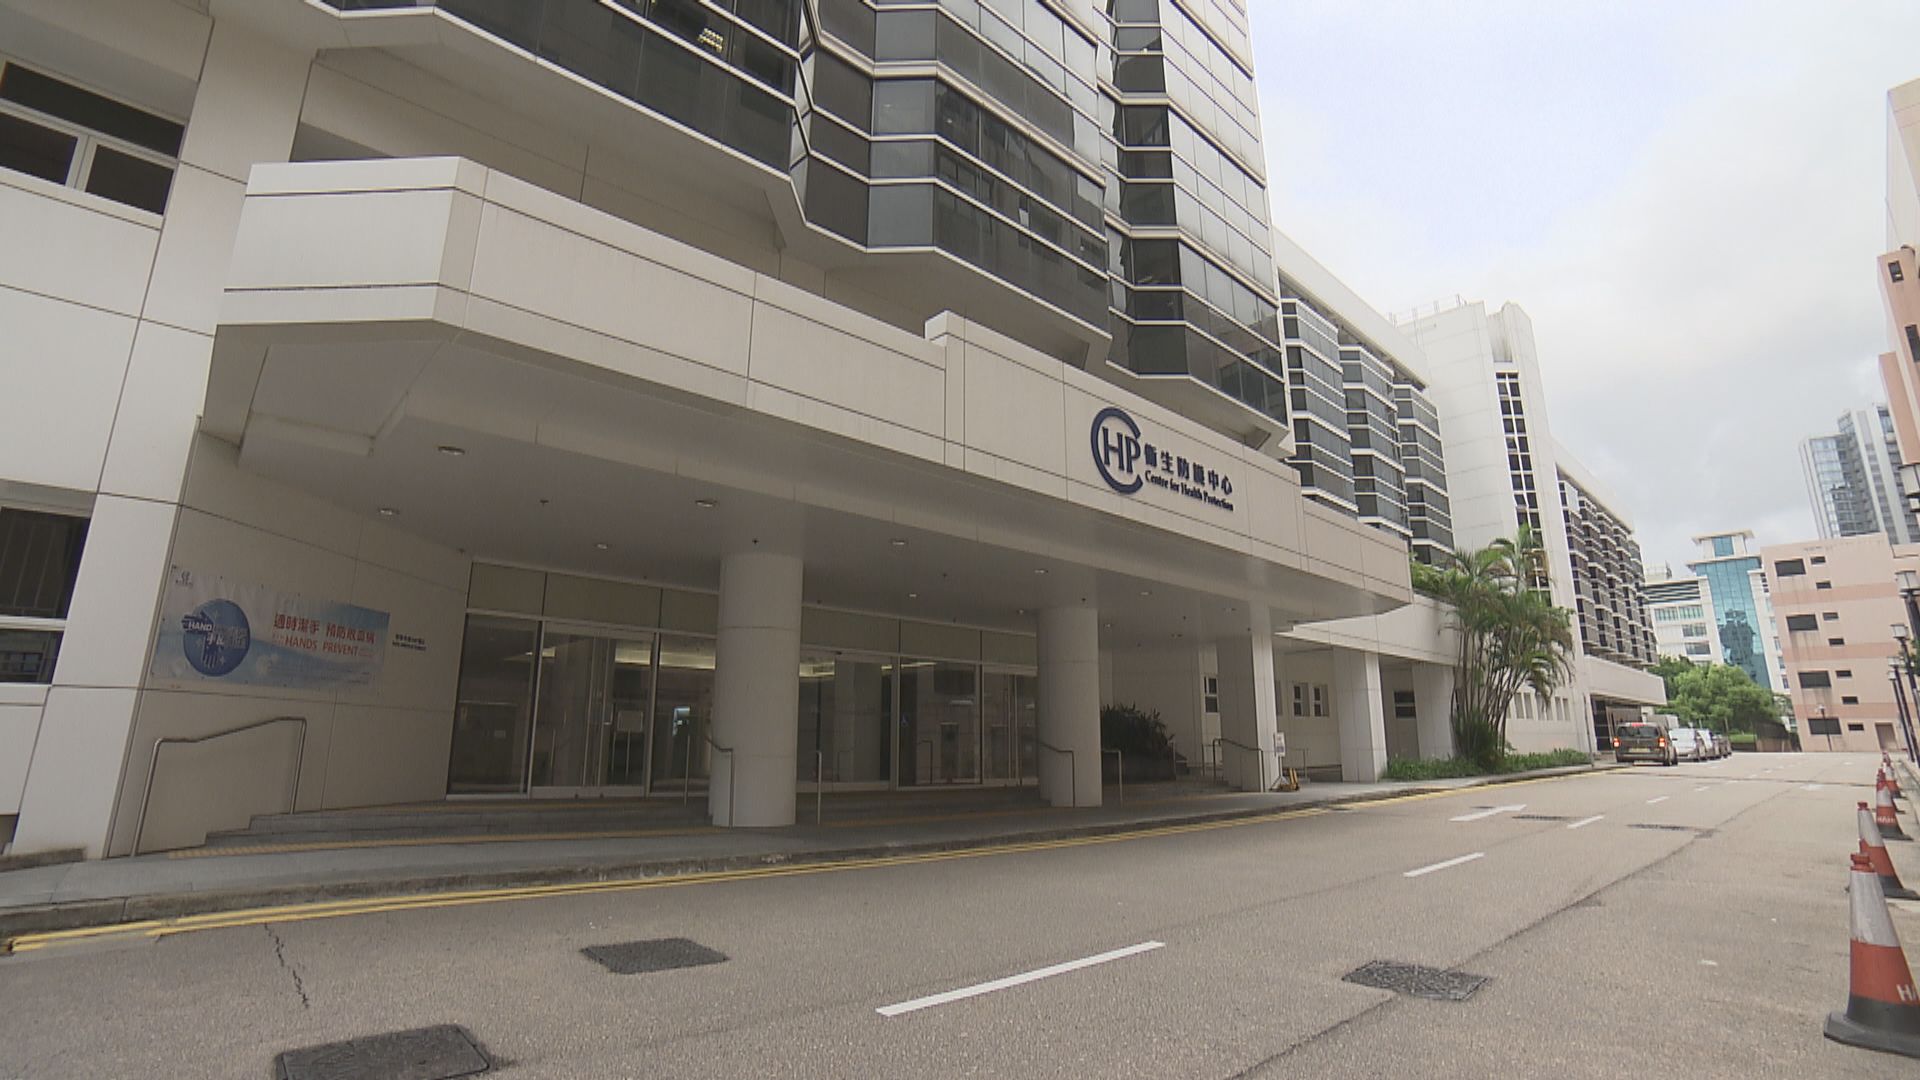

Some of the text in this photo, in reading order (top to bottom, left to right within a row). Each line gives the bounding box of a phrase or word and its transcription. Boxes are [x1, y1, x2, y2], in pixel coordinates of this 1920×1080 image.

[1091, 407, 1143, 494] CHP
[1145, 470, 1234, 511] Centre for Health Protection
[189, 621, 213, 632] HAND
[285, 634, 318, 650] HANDS
[323, 640, 359, 656] PREVENT
